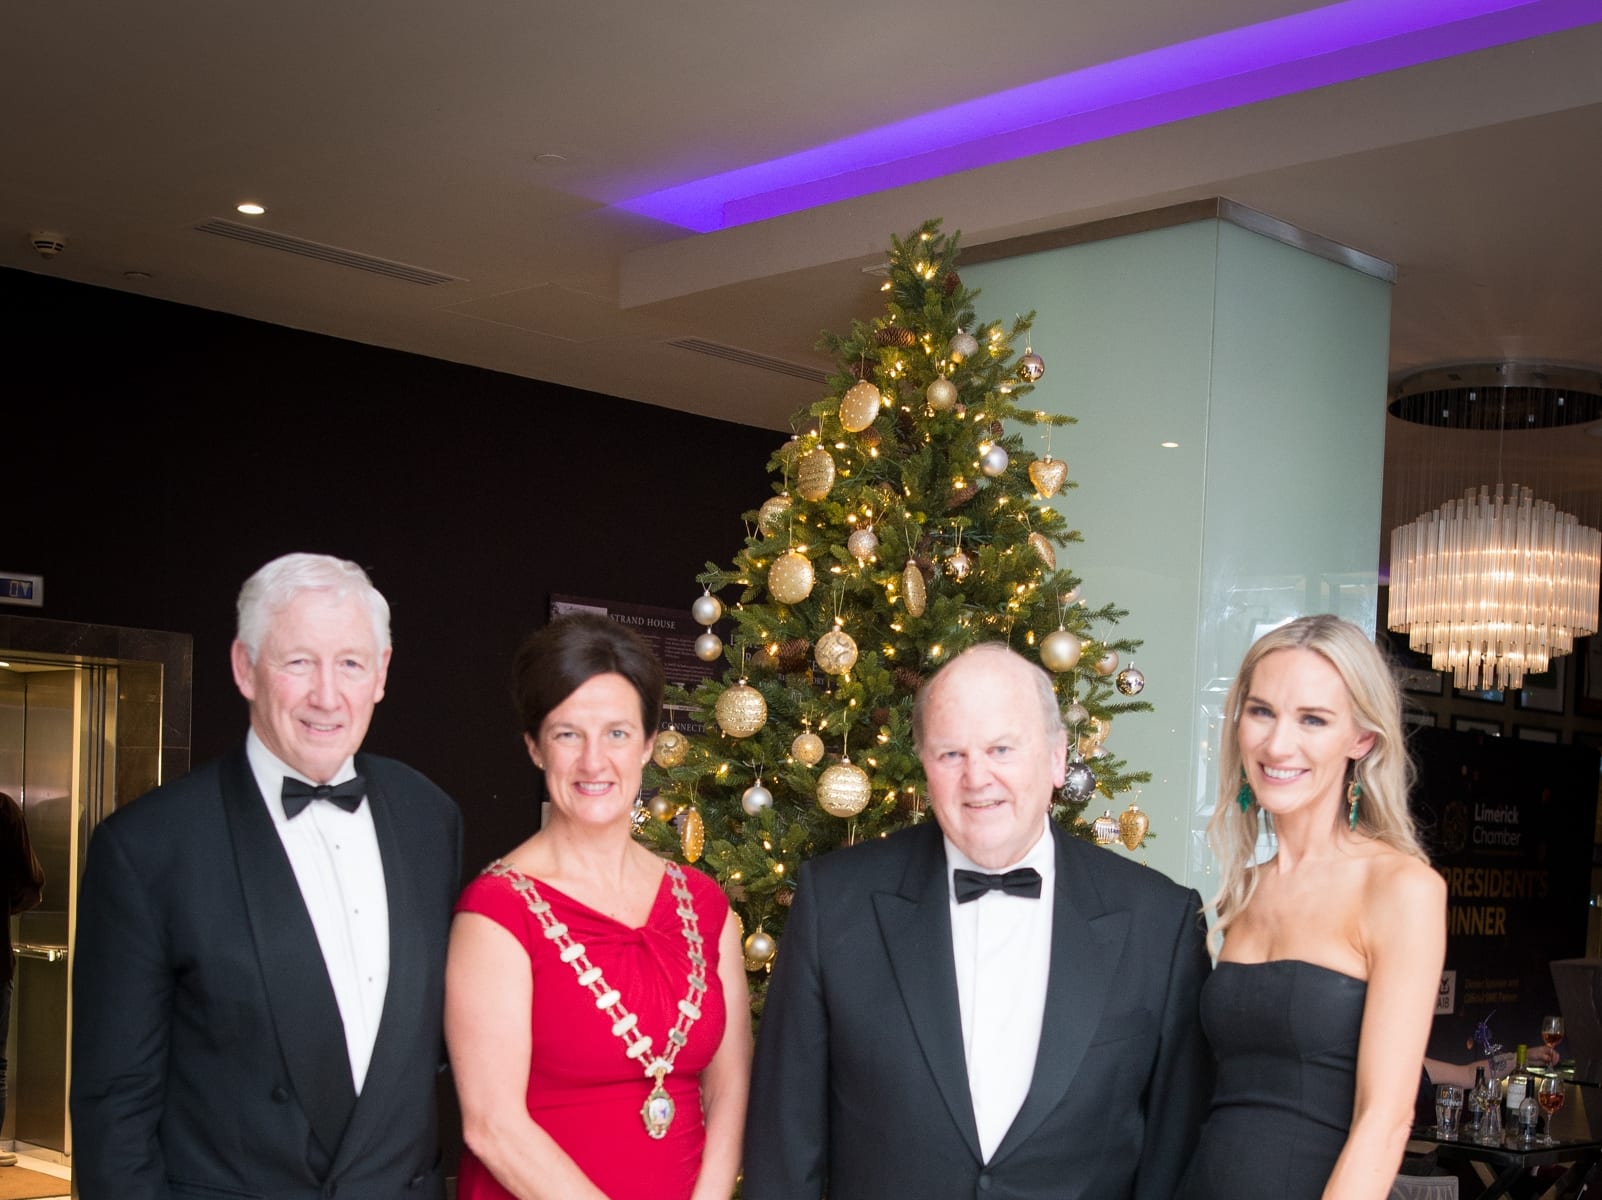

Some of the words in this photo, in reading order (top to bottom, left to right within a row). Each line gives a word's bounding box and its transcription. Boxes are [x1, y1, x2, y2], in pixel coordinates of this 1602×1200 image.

[610, 614, 644, 625] STRAND
[647, 617, 676, 629] HOUSE
[1474, 803, 1519, 824] Limerick
[1473, 826, 1521, 846] Chamber
[1448, 905, 1506, 936] INNER
